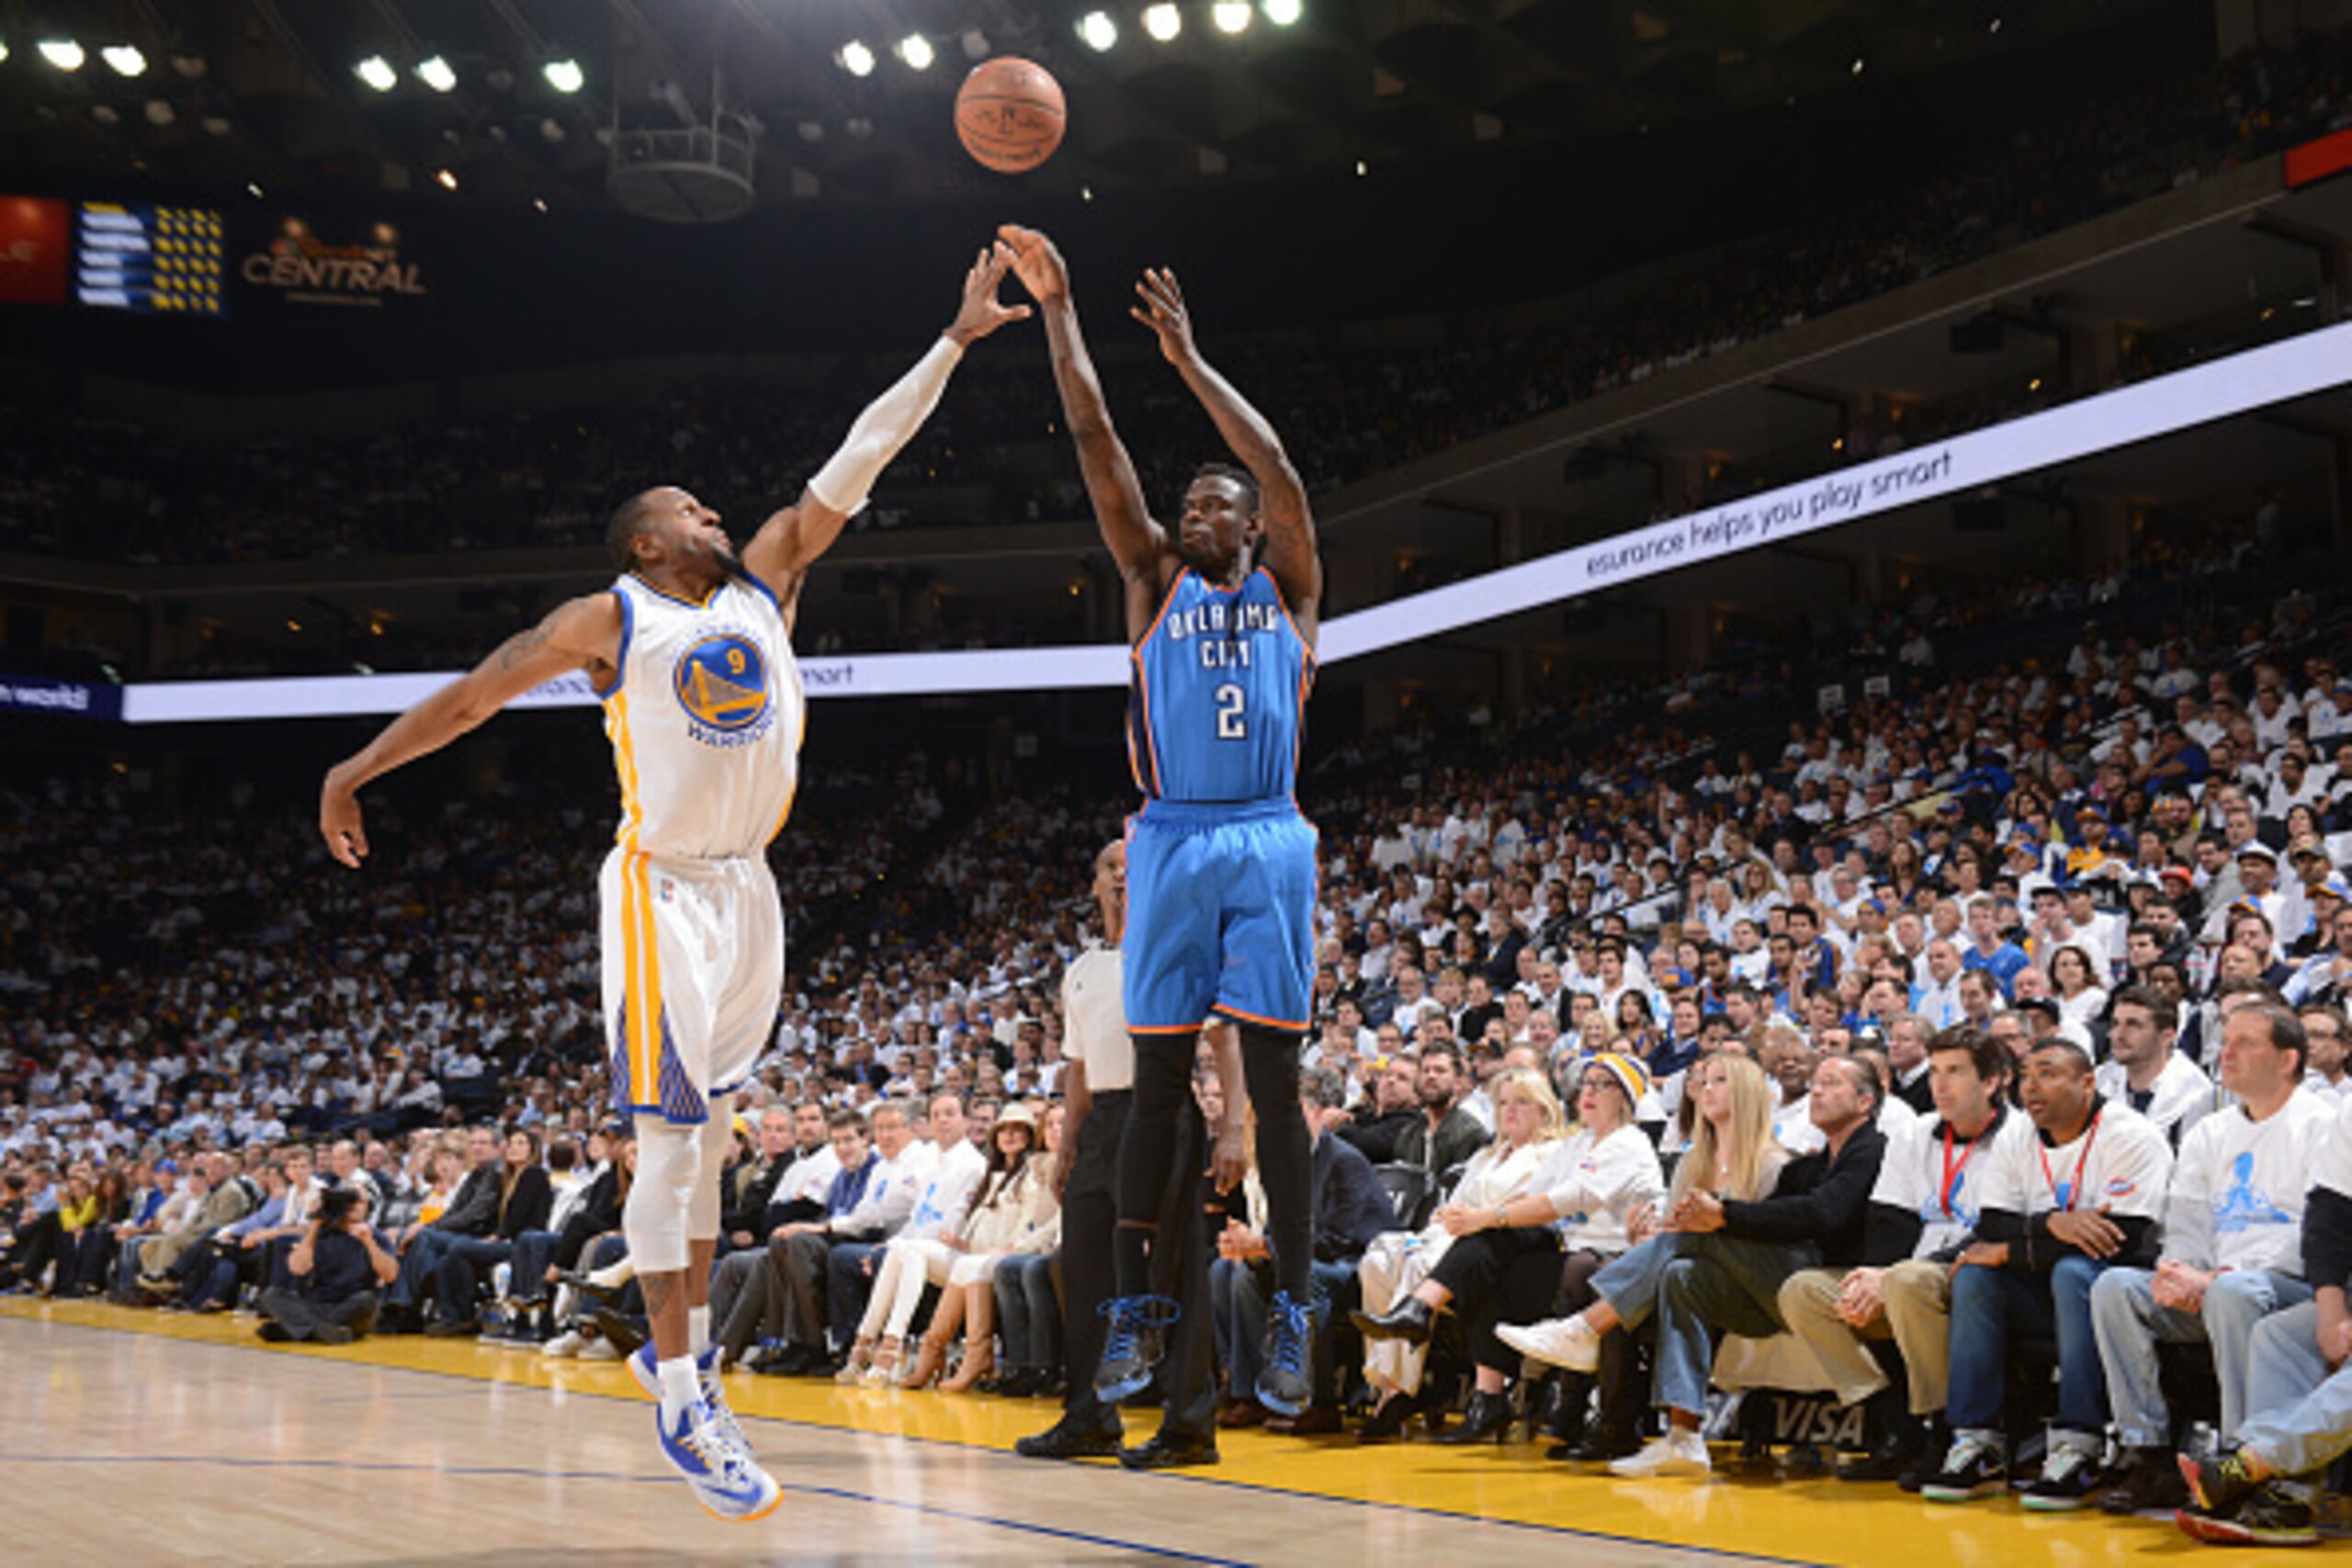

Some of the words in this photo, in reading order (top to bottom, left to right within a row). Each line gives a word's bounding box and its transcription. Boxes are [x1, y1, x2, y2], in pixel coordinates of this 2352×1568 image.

[242, 254, 425, 294] CENTRAL
[1585, 532, 1685, 578] esurance
[1690, 512, 1756, 546] helps
[1758, 497, 1804, 534] you
[1810, 476, 1863, 517] play
[1871, 449, 1953, 497] smart
[726, 648, 747, 675] 9
[1216, 683, 1246, 739] 2
[1772, 1397, 1865, 1446] VISA
